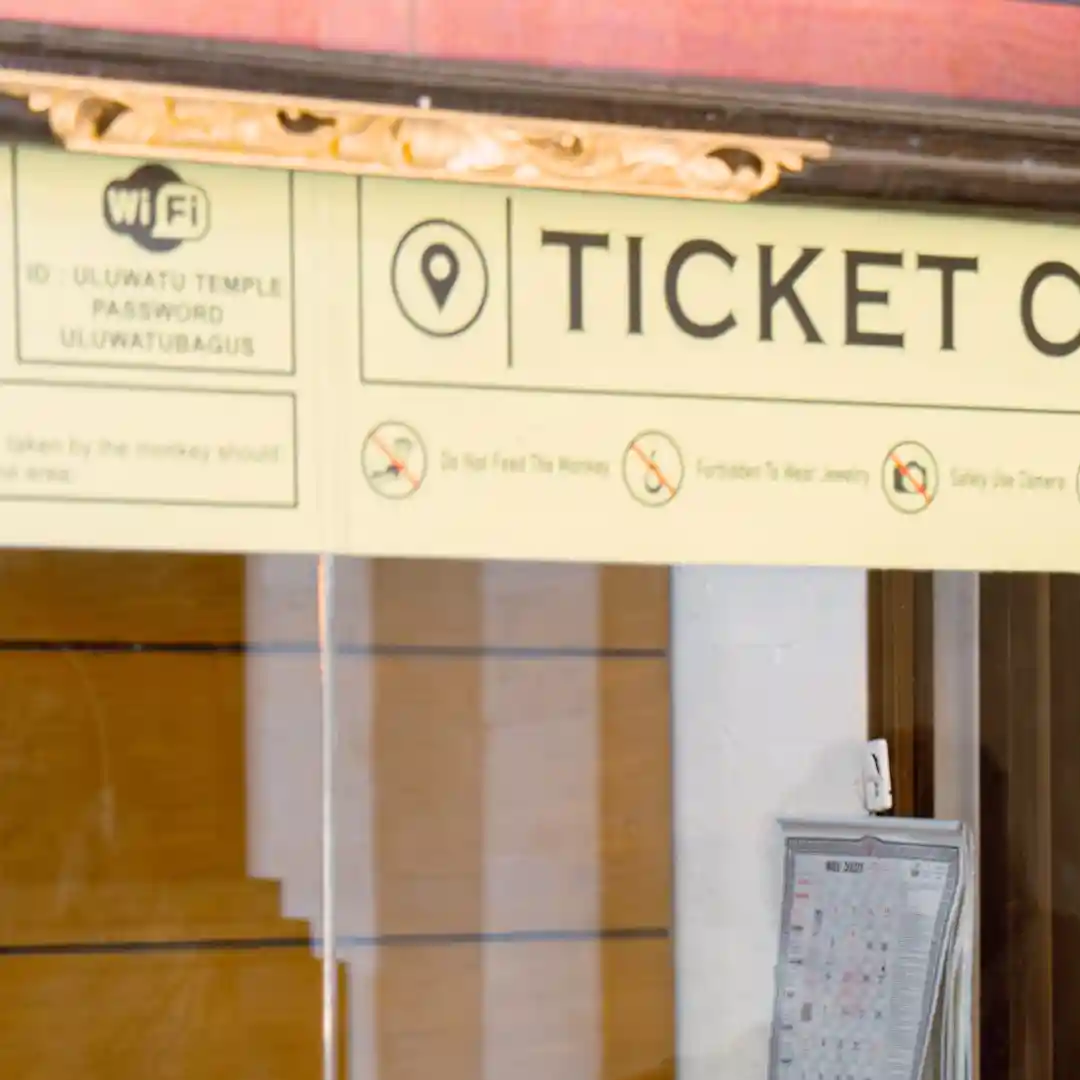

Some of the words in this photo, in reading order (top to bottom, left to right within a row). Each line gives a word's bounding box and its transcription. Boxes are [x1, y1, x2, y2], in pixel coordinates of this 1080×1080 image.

[26, 262, 51, 285] ID
[73, 267, 186, 293] ULUWATU
[195, 273, 284, 297] TEMPLE
[540, 228, 980, 351] TICKET
[91, 298, 224, 325] PASSWORD
[60, 328, 256, 358] ULUWATUBAGUS
